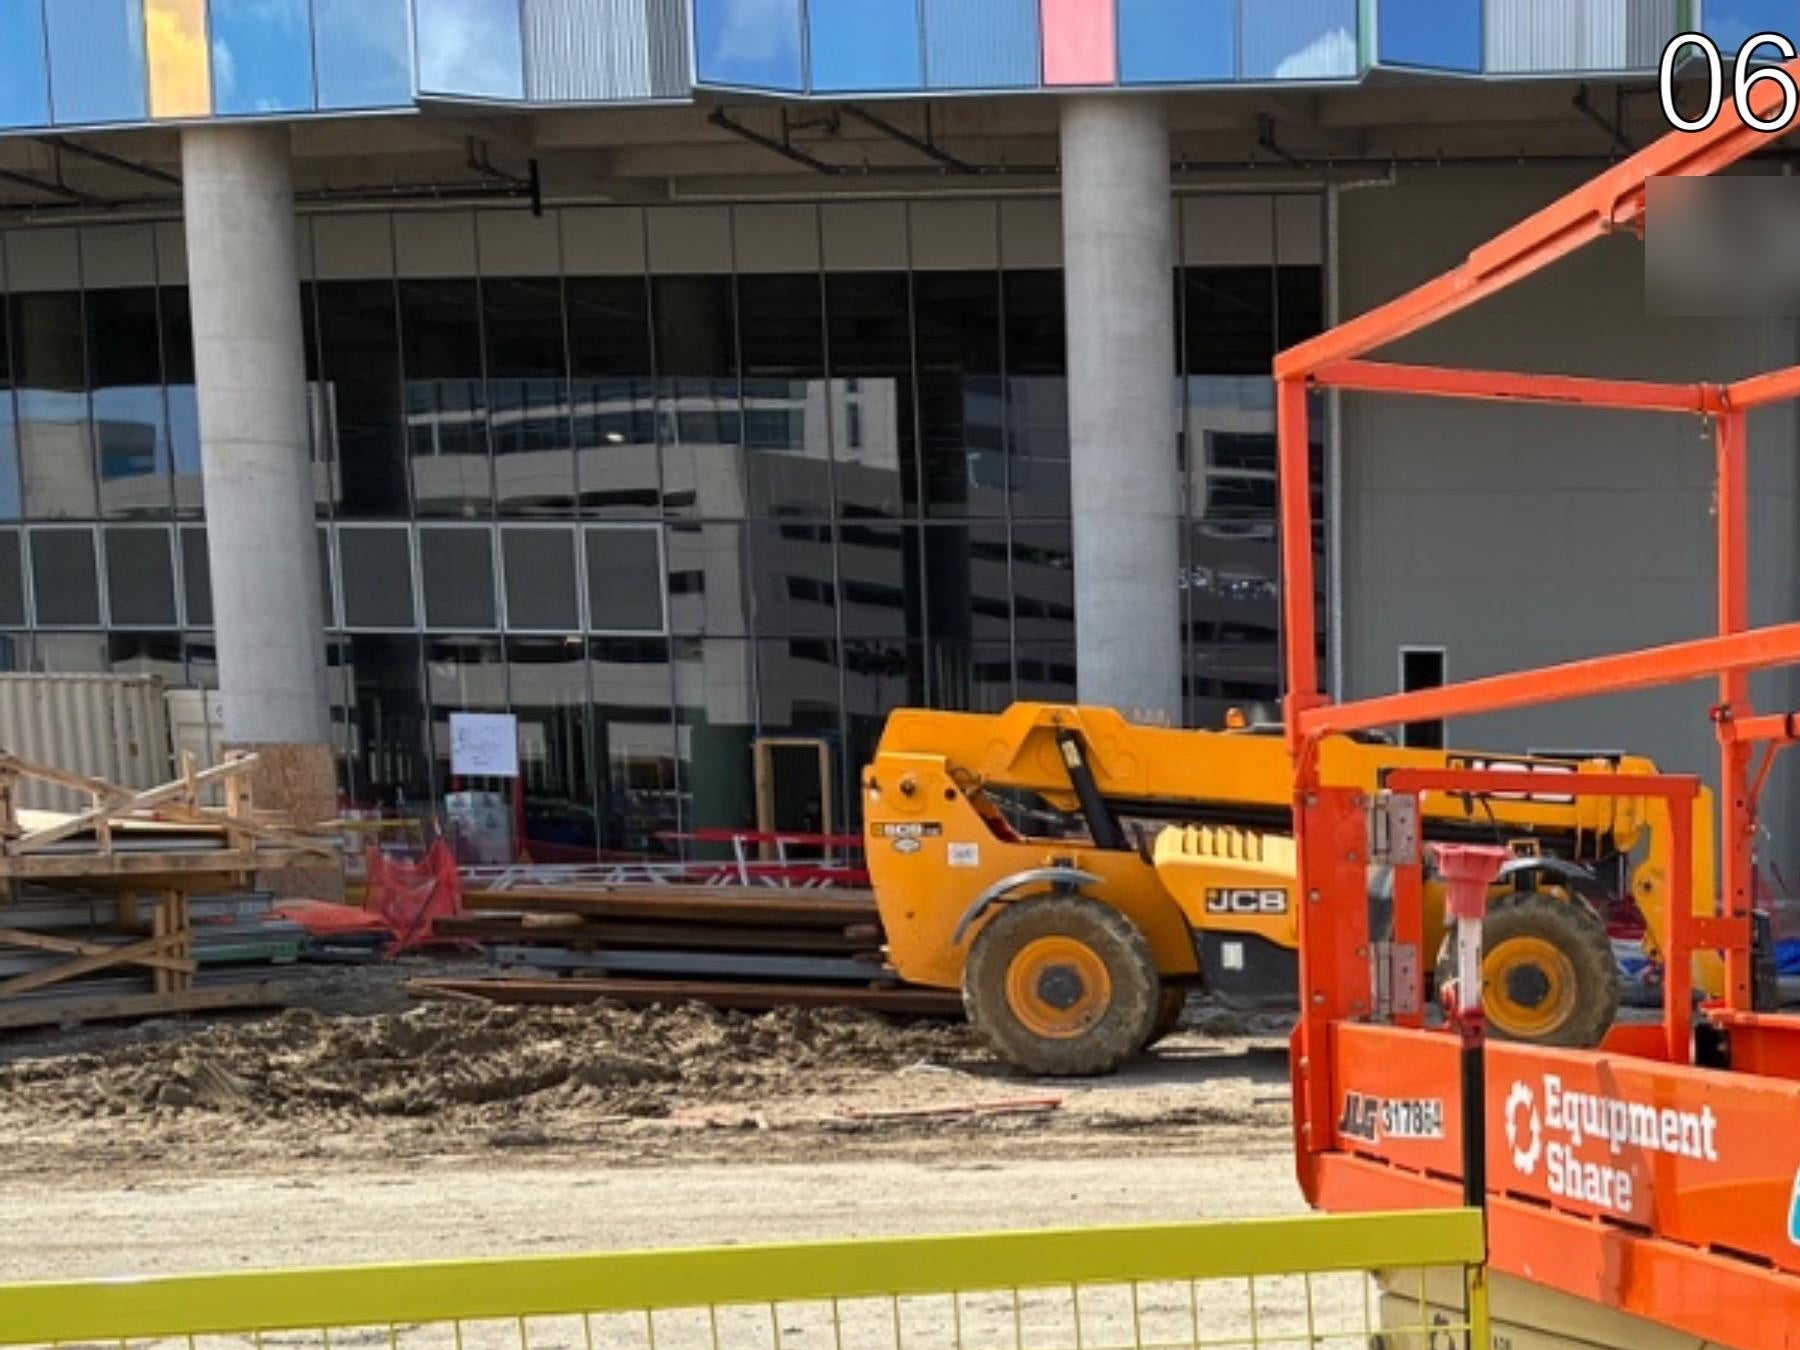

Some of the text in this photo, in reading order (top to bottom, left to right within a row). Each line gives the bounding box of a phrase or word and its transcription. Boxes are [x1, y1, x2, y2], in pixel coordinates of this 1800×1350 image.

[1207, 888, 1287, 914] JCB
[1338, 1095, 1378, 1140] JLG
[1543, 1074, 1719, 1161] Equipment
[1546, 1141, 1634, 1212] Share
